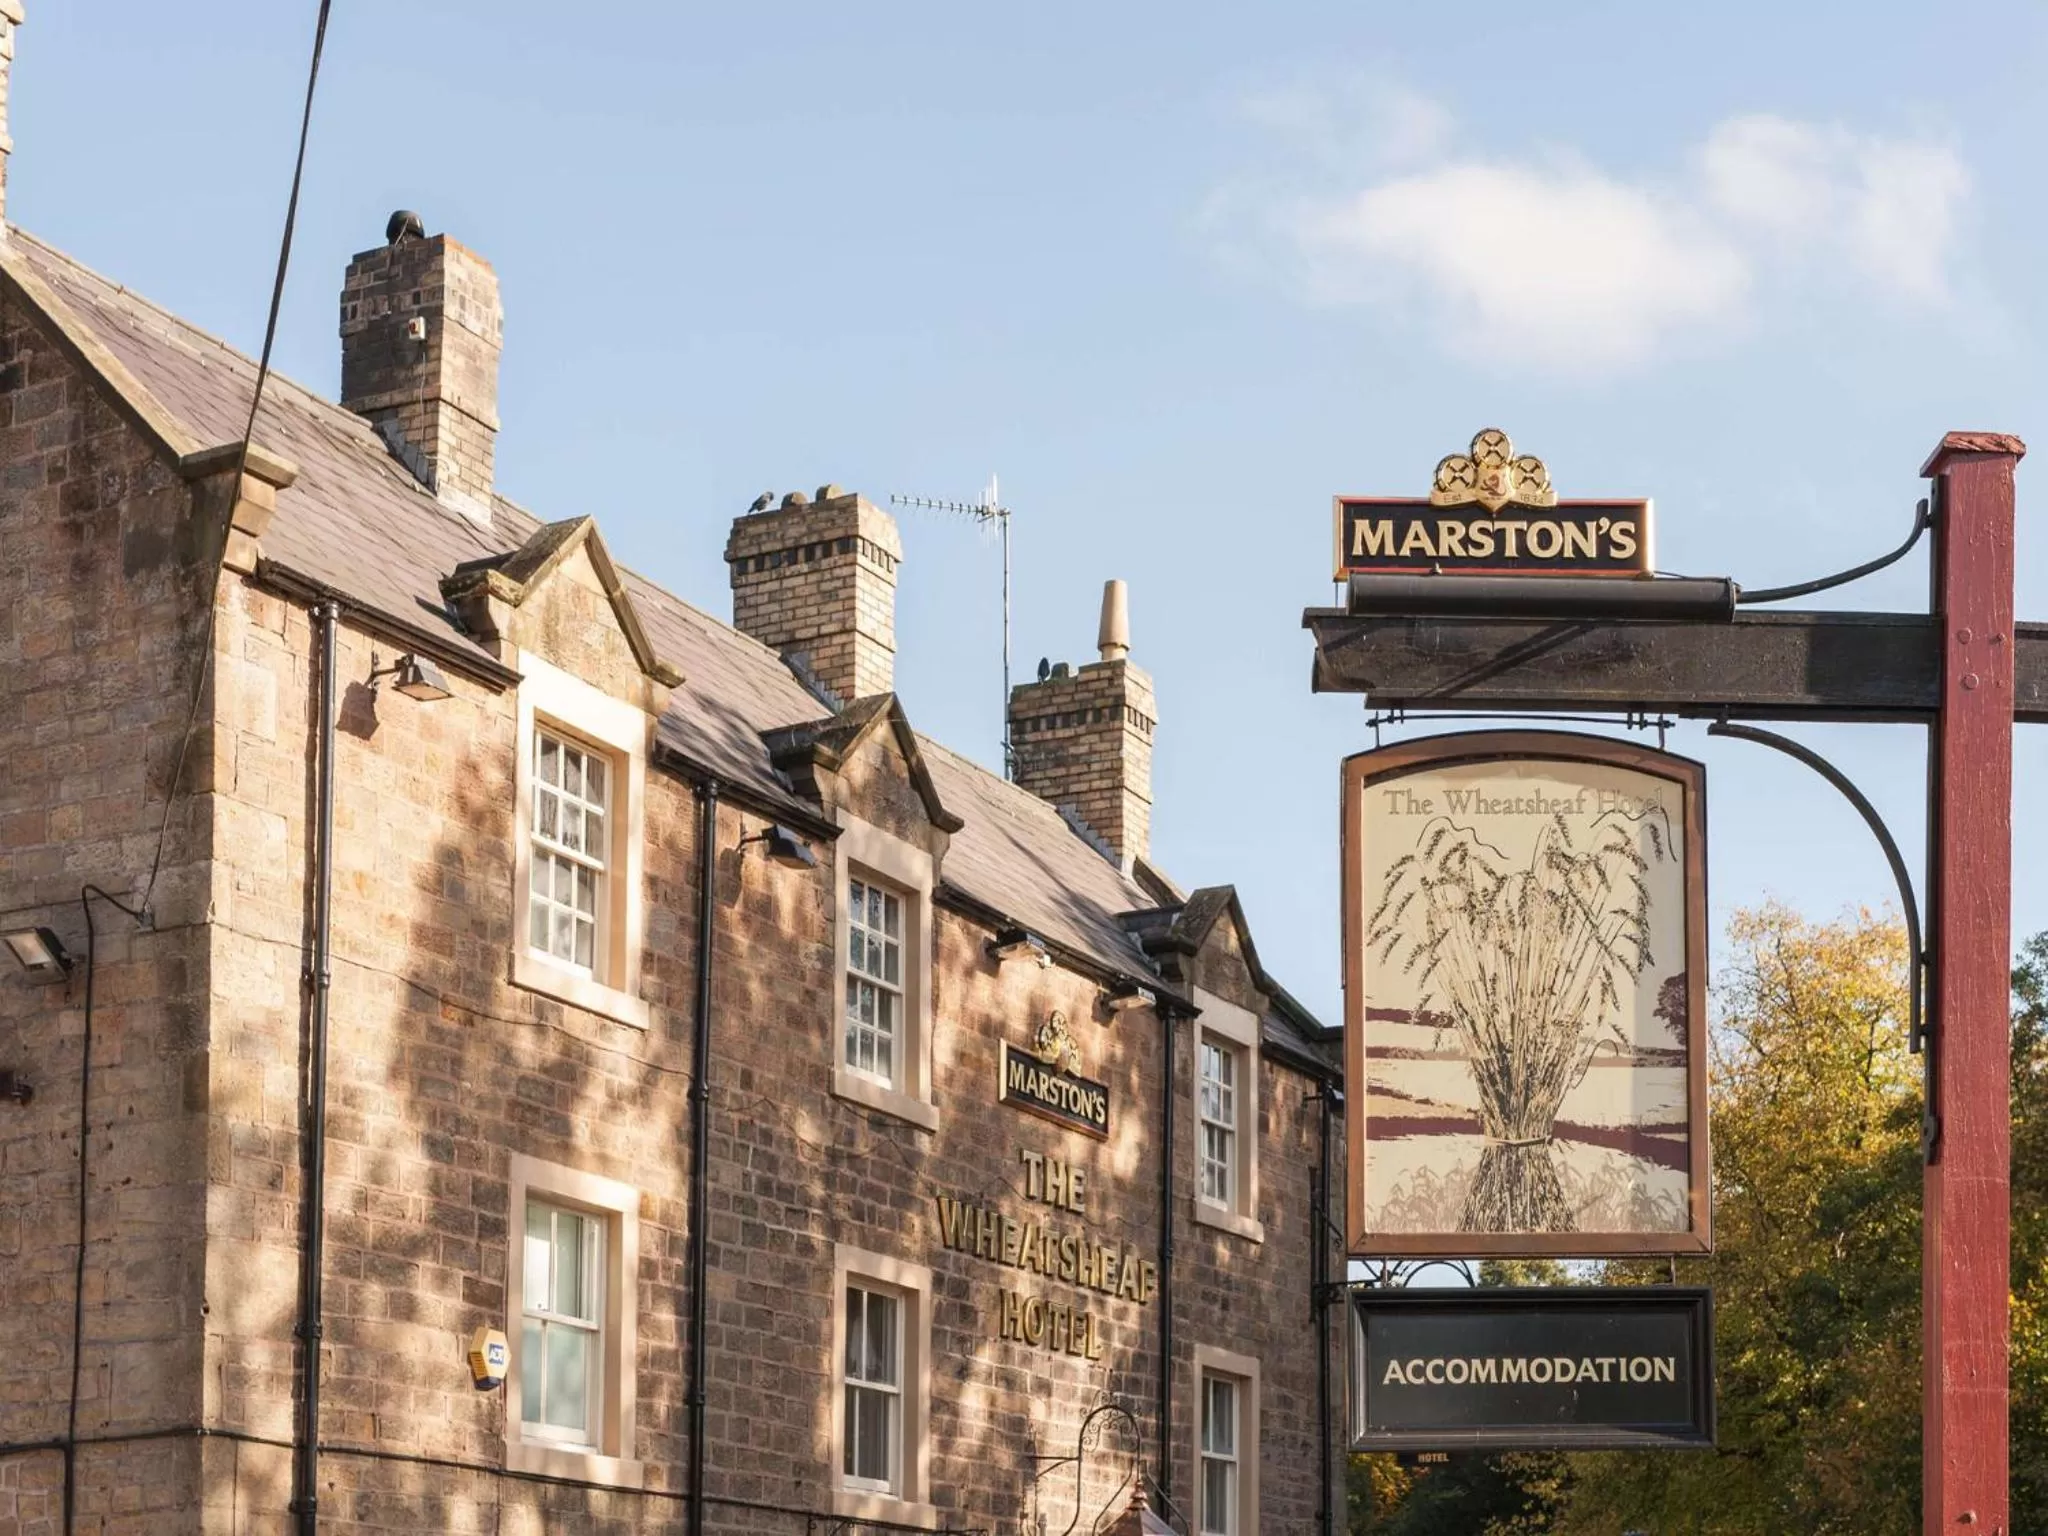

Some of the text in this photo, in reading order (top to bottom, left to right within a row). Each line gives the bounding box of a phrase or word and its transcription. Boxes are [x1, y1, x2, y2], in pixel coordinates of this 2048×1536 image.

[1351, 516, 1637, 559] MARSTON'S
[1383, 788, 1434, 816] The
[1442, 788, 1587, 816] Wheatsheaf
[1008, 1059, 1106, 1125] MARSTON'S
[1022, 1149, 1086, 1214] THE
[937, 1196, 1156, 1306] WHEATSHEAF
[1000, 1289, 1102, 1361] HOTEL
[1382, 1357, 1676, 1385] ACCOMMODATION
[1417, 1452, 1449, 1463] HOTEL
